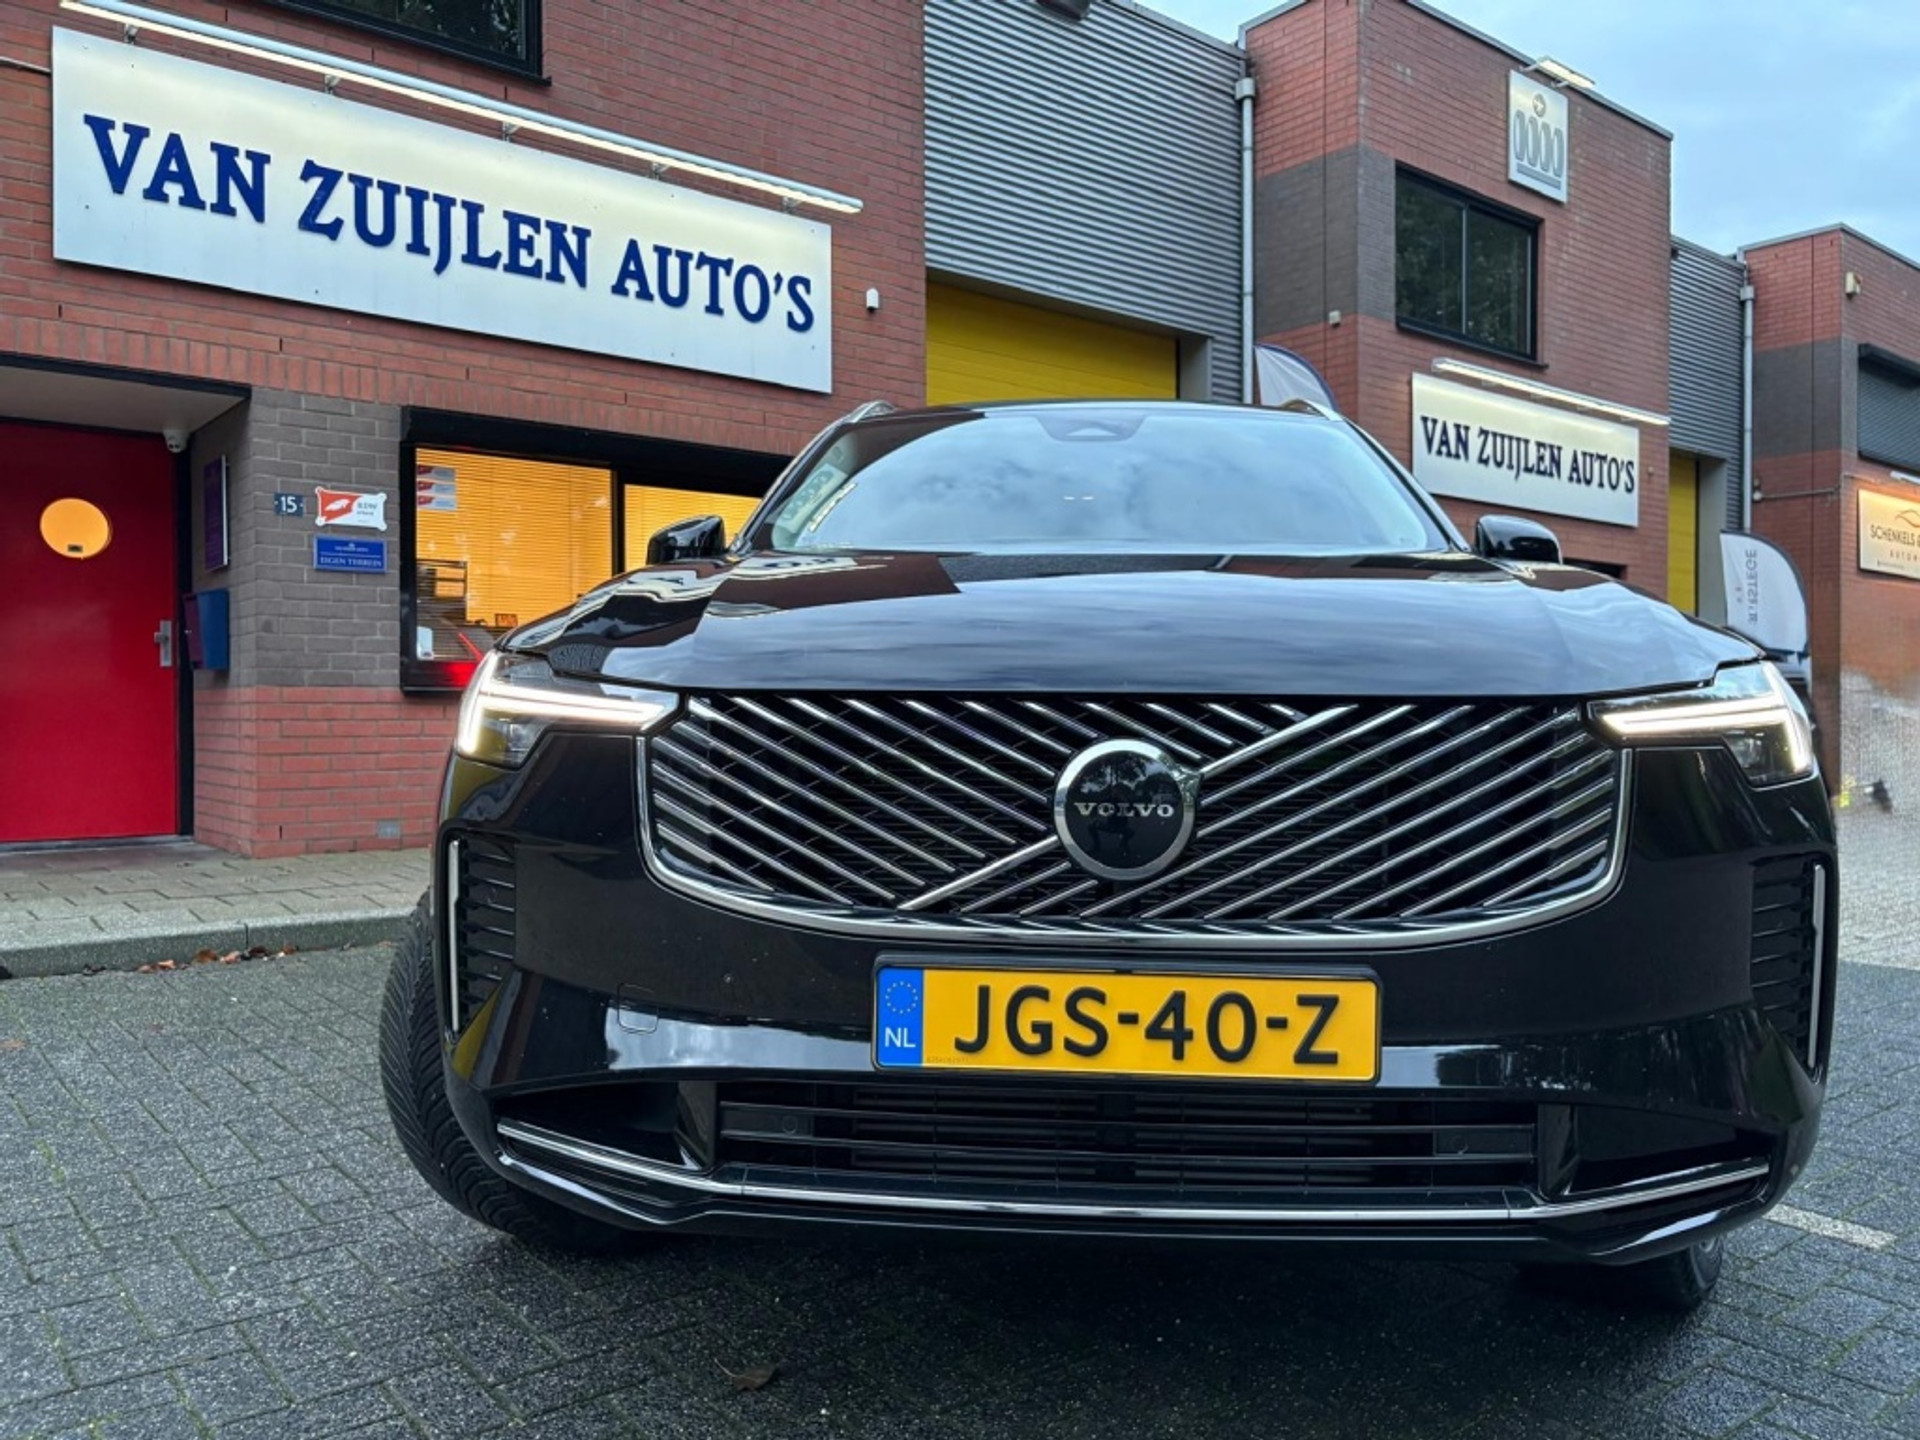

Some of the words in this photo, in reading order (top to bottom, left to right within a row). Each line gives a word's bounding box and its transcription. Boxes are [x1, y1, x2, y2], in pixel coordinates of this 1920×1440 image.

[83, 114, 271, 224] VAN
[298, 159, 591, 289] ZUIJLEN
[611, 237, 815, 333] AUTO'S
[1420, 415, 1470, 462] VAN
[1477, 427, 1563, 481] ZUIJLEN
[1567, 449, 1635, 494] AUTO'S
[280, 495, 298, 513] 15
[320, 556, 346, 565] EIGEN
[1073, 802, 1175, 818] VOLVO
[953, 983, 1340, 1065] JGS-40-Z
[884, 1027, 916, 1048] NL
